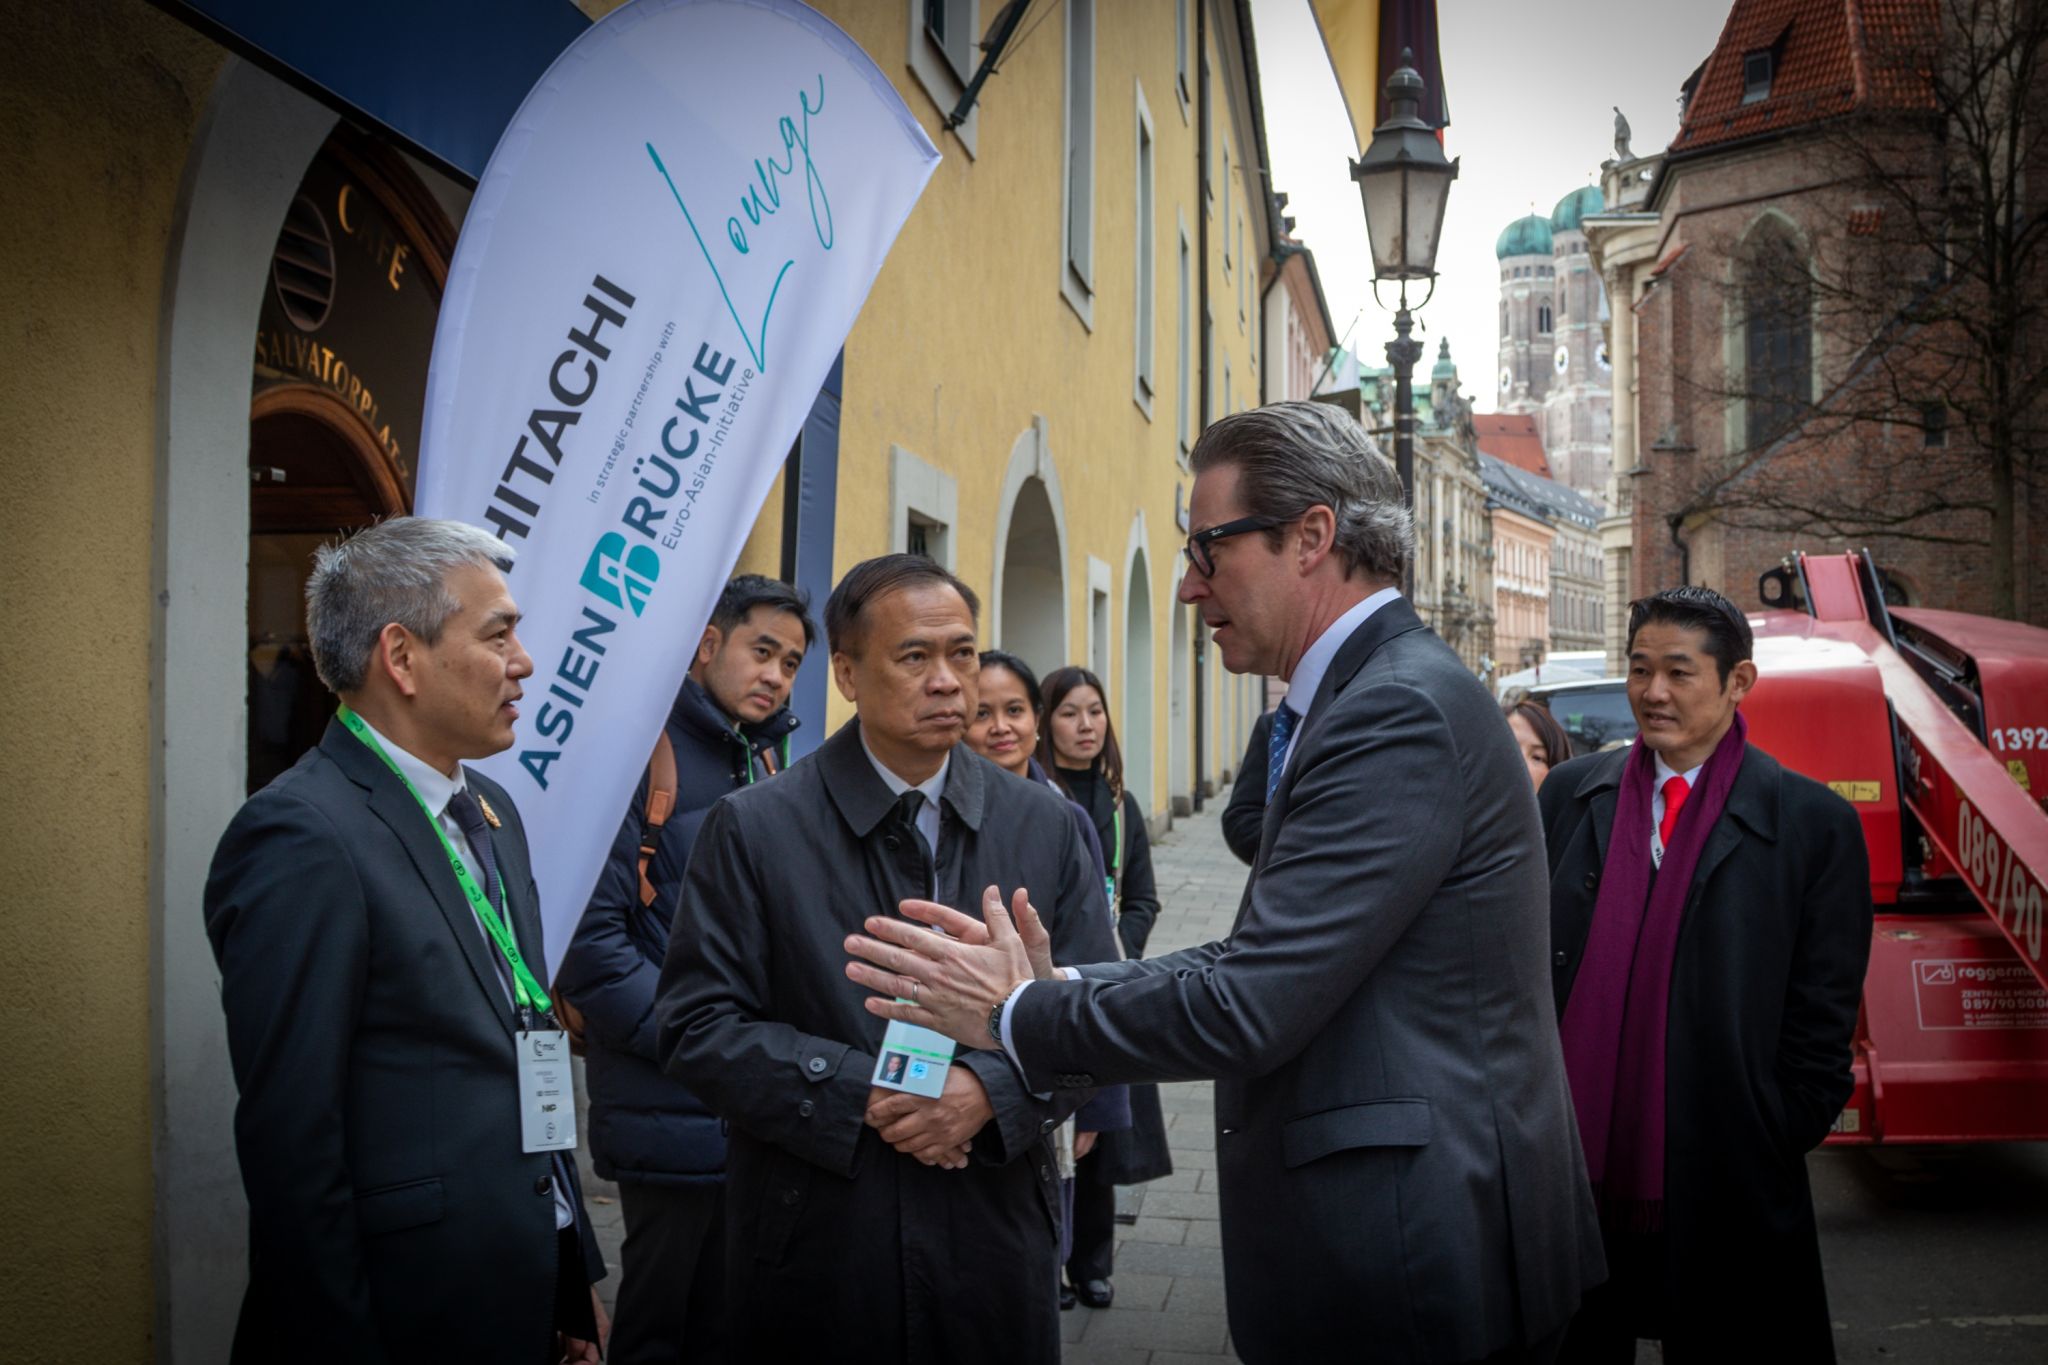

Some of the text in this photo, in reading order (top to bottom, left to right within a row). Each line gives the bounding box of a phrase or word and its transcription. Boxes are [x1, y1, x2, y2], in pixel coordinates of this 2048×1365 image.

[646, 74, 834, 373] Lounge
[484, 274, 637, 574] HITACHI
[587, 320, 677, 504] in strategic partnership with
[661, 366, 755, 551] Euro-Asian-Initiative
